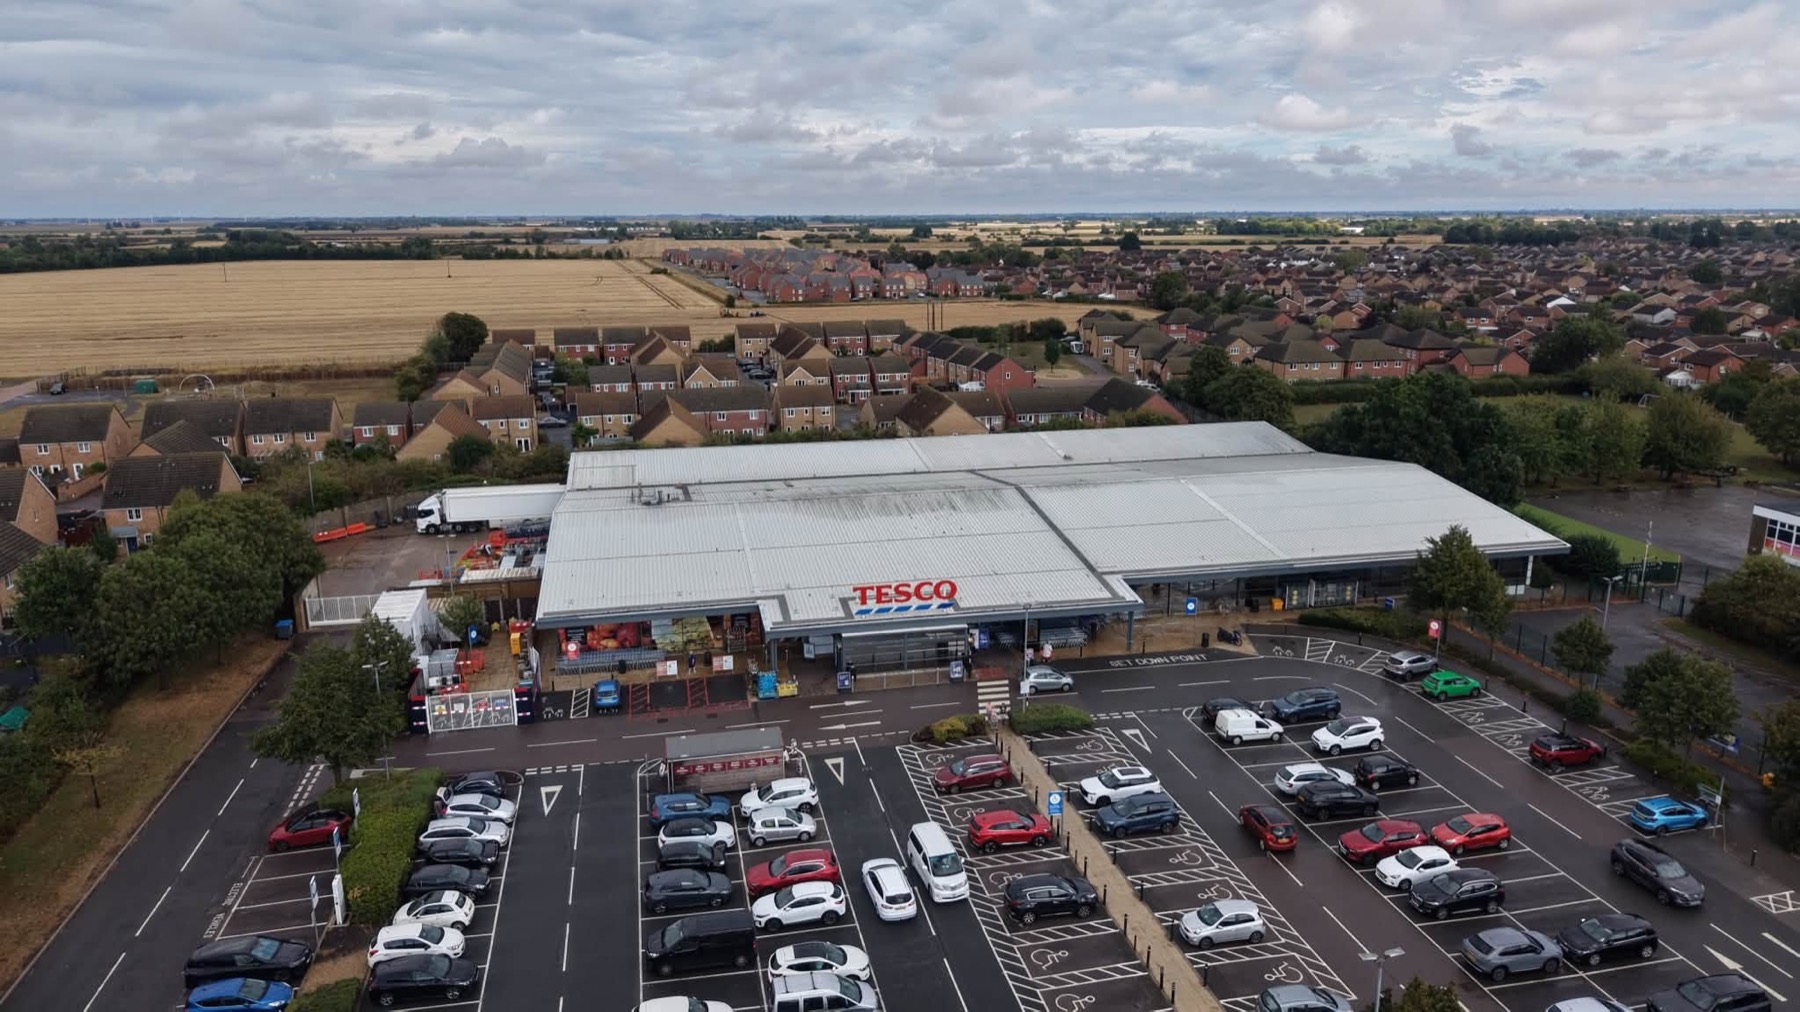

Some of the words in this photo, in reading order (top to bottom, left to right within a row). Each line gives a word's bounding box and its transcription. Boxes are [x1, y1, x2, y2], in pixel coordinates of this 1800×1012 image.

[853, 580, 957, 605] TESCO
[1135, 657, 1170, 665] DOWN
[1169, 654, 1207, 662] POINT
